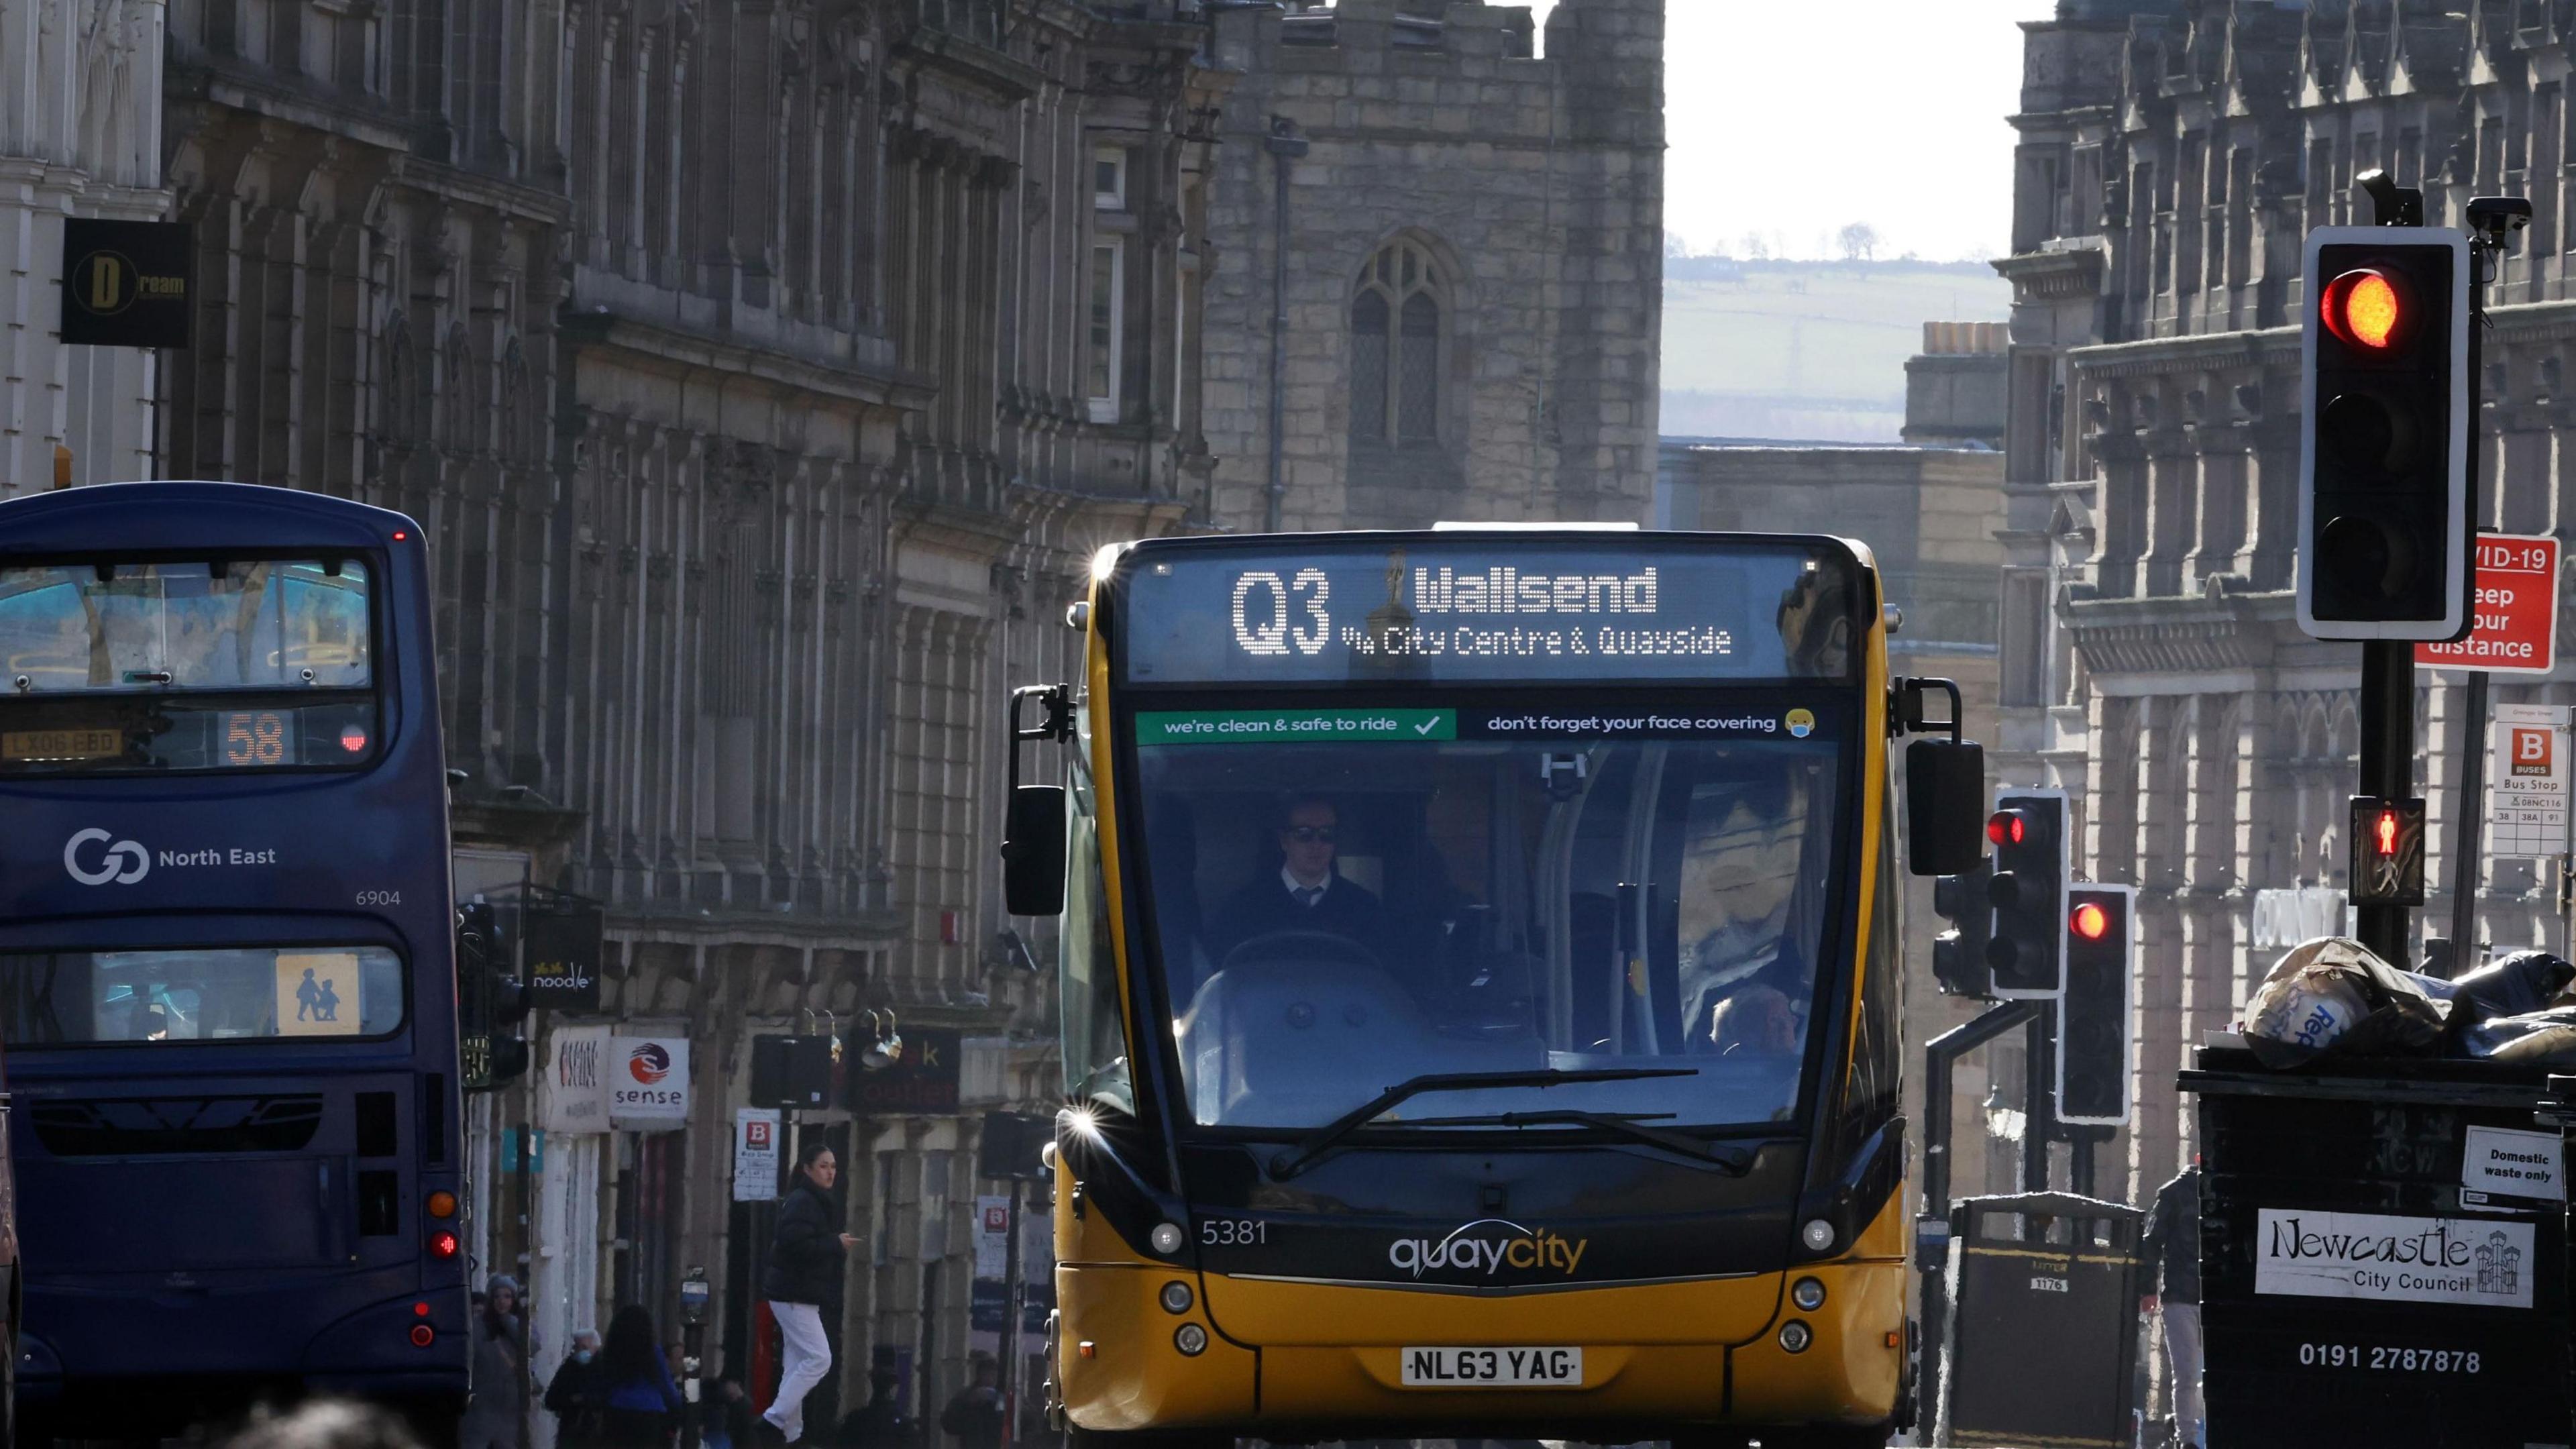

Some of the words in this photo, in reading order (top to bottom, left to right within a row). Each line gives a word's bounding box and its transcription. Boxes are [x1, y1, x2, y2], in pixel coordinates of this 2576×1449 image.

[2475, 588, 2515, 608] eep
[1232, 568, 1330, 655] Q3
[1415, 566, 1657, 613] Wallsend
[2473, 614, 2510, 631] our
[1383, 627, 1445, 655] City
[1454, 627, 1562, 655] Centre
[1570, 627, 1591, 655] &
[1599, 626, 1731, 655] Quayside
[1165, 719, 1214, 734] we're
[1218, 719, 1271, 733] clean
[1274, 718, 1287, 732] &
[1291, 717, 1333, 732] safe
[1336, 718, 1356, 731] to
[1360, 717, 1397, 731] ride
[1487, 716, 1537, 731] don't
[1539, 715, 1599, 733] forget
[1603, 718, 1644, 733] your
[1648, 715, 1691, 730] face
[1695, 716, 1777, 733] covering
[228, 713, 283, 765] 58
[2520, 733, 2544, 761] B
[2516, 765, 2546, 774] BUSES
[2504, 779, 2526, 790] Bus
[2530, 780, 2559, 792] Stop
[2522, 799, 2561, 807] 08NC116
[2499, 812, 2510, 820] 38
[2522, 813, 2538, 821] 38A
[159, 847, 221, 867] North
[229, 847, 276, 865] East
[356, 890, 401, 906] 6904
[533, 961, 589, 993] noodle
[615, 1089, 683, 1104] sense
[751, 1125, 766, 1140] B
[2490, 1148, 2549, 1165] Domestic
[2484, 1167, 2522, 1178] waste
[2524, 1170, 2552, 1183] only
[1202, 1220, 1267, 1244] 5381
[1389, 1228, 1588, 1276] quaycity
[2270, 1218, 2469, 1267] Newcastle
[2037, 1279, 2062, 1290] 1176
[2353, 1270, 2390, 1289] City
[2398, 1274, 2470, 1293] Council
[1414, 1351, 1497, 1379] NL63
[1507, 1351, 1569, 1379] YAG
[2299, 1343, 2359, 1367] 0191
[2369, 1346, 2481, 1374] 2787878
